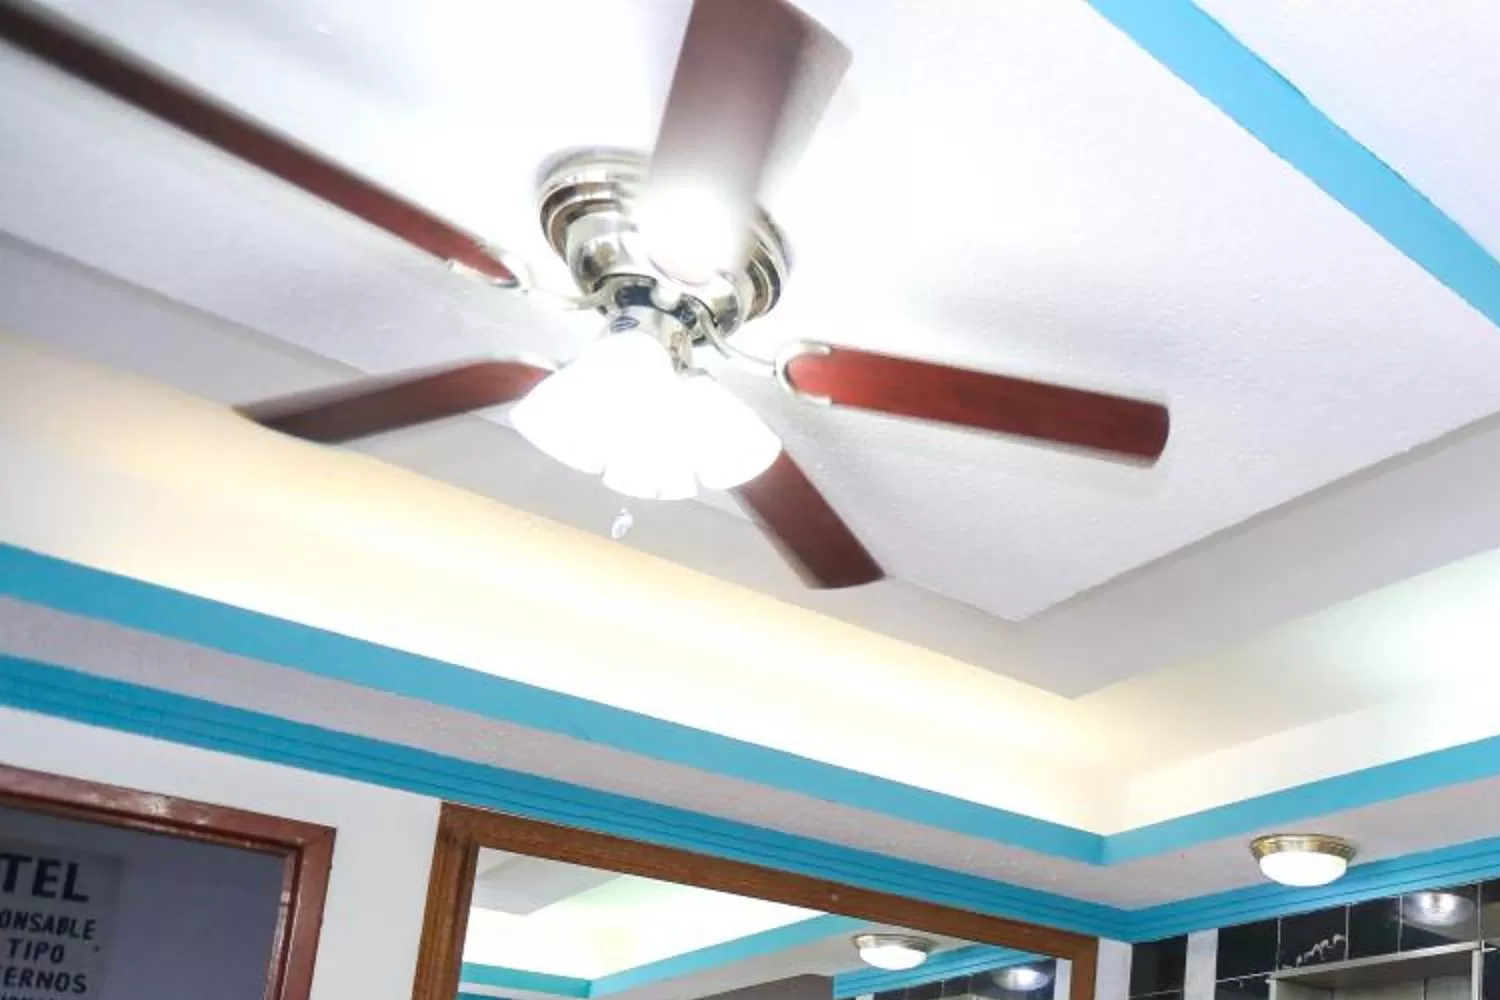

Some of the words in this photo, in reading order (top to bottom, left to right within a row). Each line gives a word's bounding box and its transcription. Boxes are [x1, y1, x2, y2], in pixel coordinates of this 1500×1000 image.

[0, 852, 89, 903] TEL
[8, 937, 65, 963] TIPO
[0, 966, 86, 994] ERNOS
